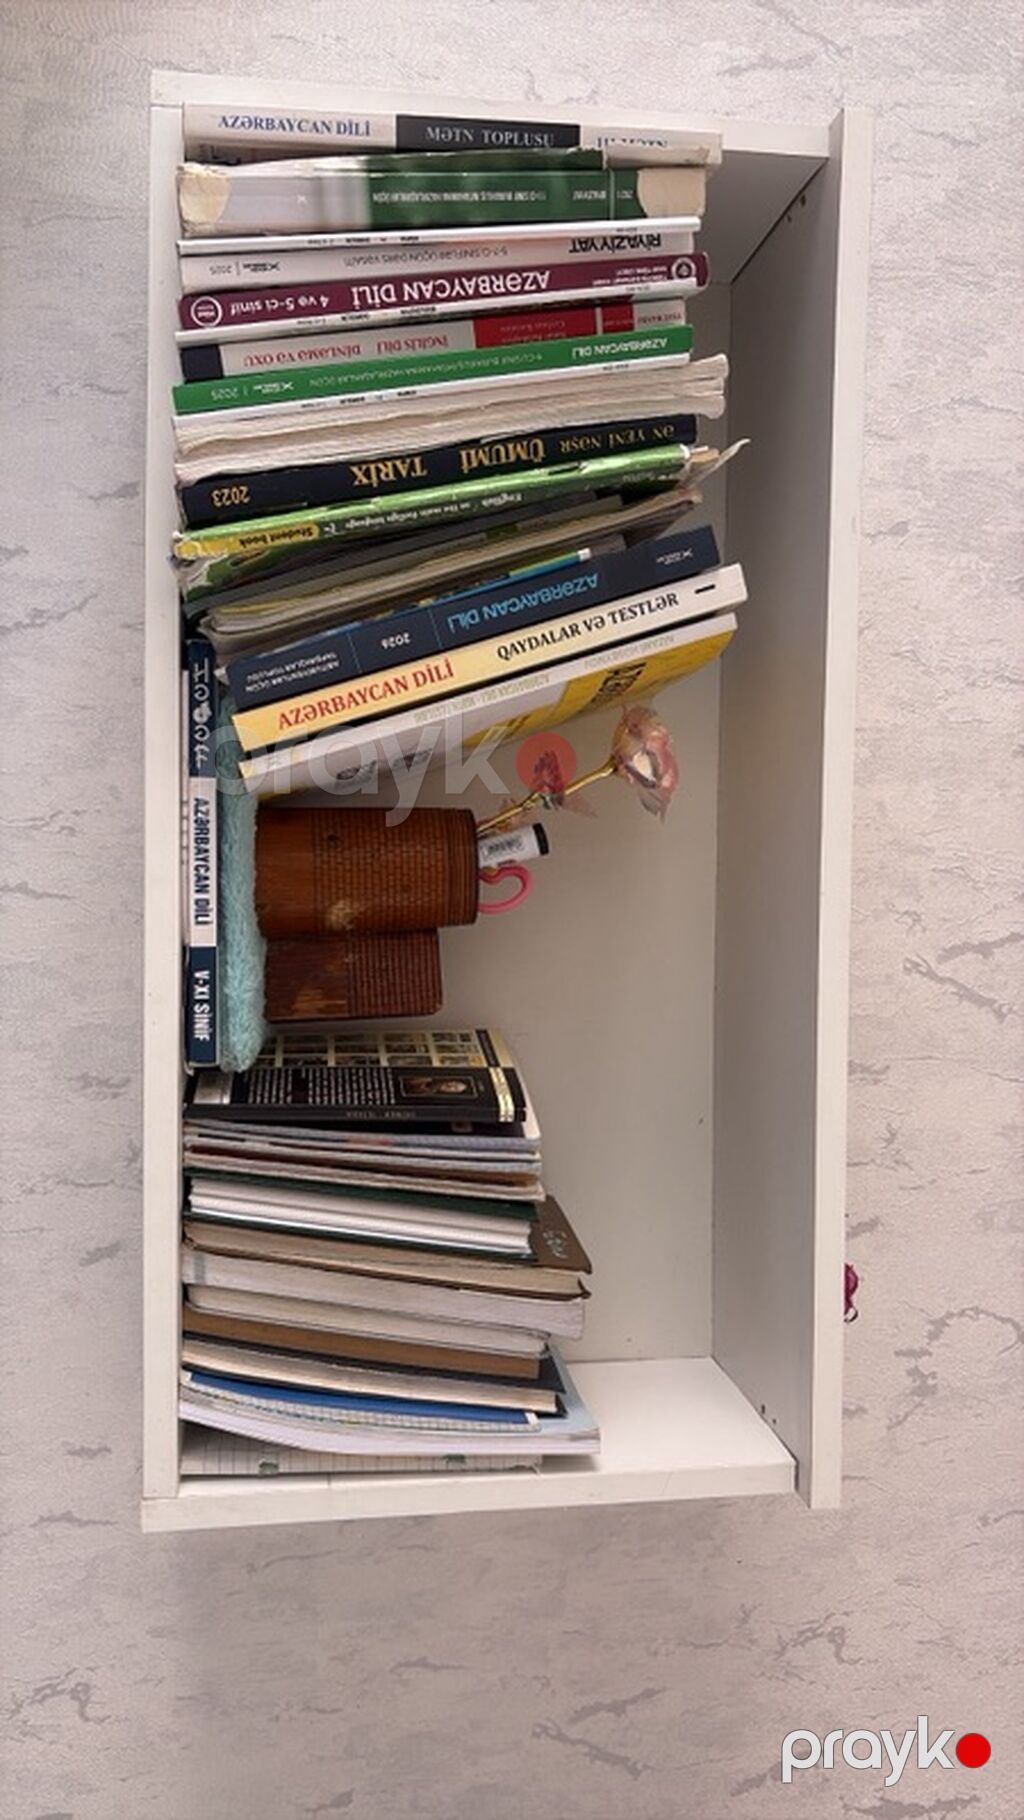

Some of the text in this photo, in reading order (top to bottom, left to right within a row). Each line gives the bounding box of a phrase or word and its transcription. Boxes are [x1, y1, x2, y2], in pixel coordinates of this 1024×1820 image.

[218, 115, 370, 137] AZƏRBAYCAN DİLİ
[426, 123, 554, 147] MƏTN TOPLUSU
[352, 283, 396, 309] DİLİ
[403, 270, 550, 302] AZƏRBAYCAN
[231, 300, 263, 316] sinif
[266, 297, 294, 311] 5-ci
[299, 296, 317, 307] və
[321, 295, 329, 308] 4
[298, 344, 361, 362] DİNLƏMƏ
[377, 338, 401, 353] DİLİ
[572, 346, 593, 360] DİLİ
[594, 337, 668, 355] AZƏRBAYCAN
[243, 354, 274, 367] OXU
[276, 351, 294, 363] VƏ
[211, 425, 675, 507] ƏN YENİ NƏŞR ÜMUMİ TARİX 2023
[239, 526, 314, 547] Student book
[447, 573, 598, 633] AZƏRBAYCAN DİLİ
[497, 622, 581, 661] QAYDALAR
[585, 615, 606, 633] VƏ
[609, 592, 680, 626] TESTLƏR
[278, 677, 409, 730] AZƏRBAYCAN
[414, 657, 455, 688] DİLİ
[193, 798, 213, 925] AZƏRBAYCAN DİLİ
[193, 970, 213, 1042] V-XI SİNİF
